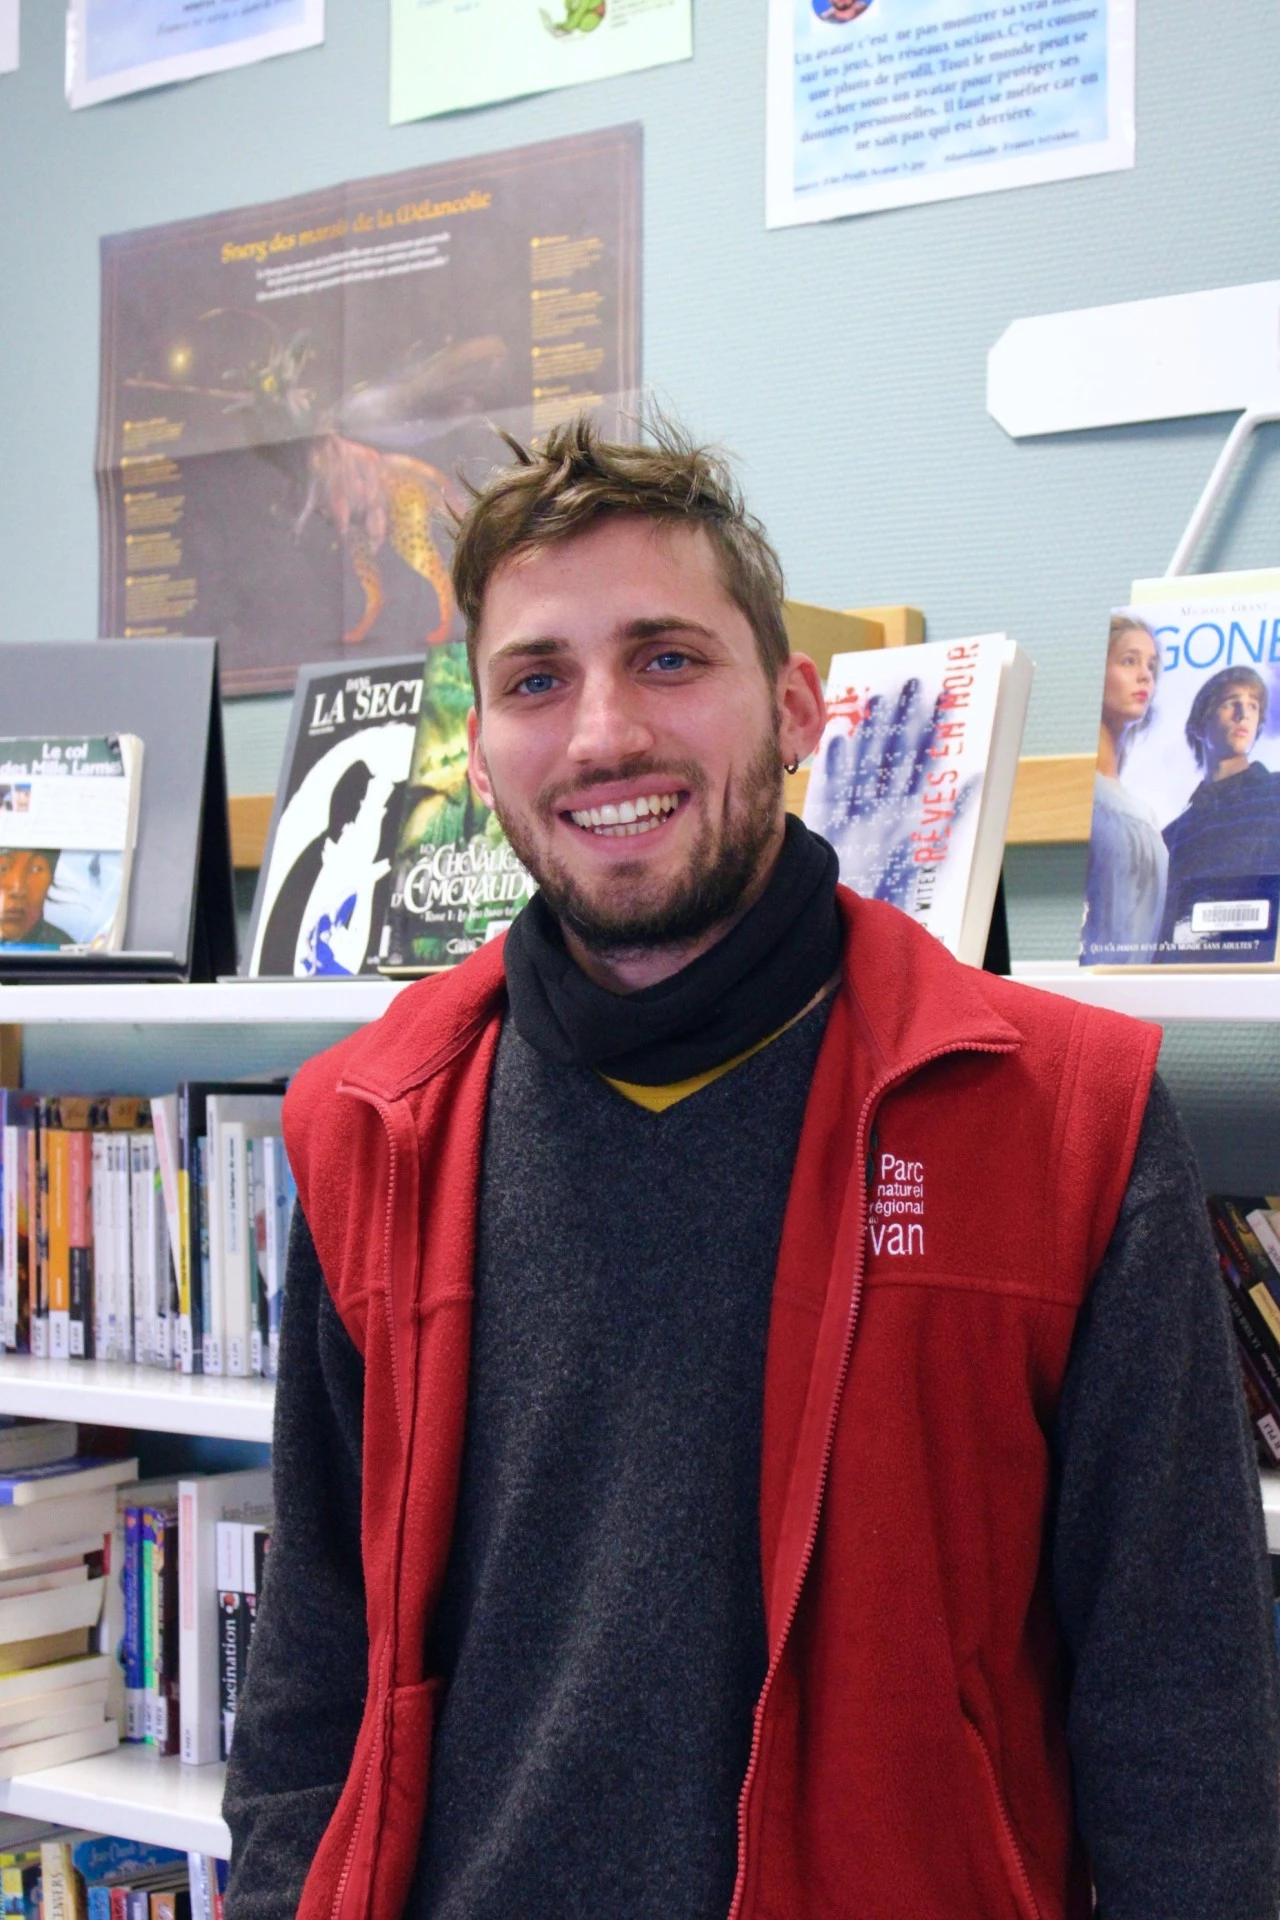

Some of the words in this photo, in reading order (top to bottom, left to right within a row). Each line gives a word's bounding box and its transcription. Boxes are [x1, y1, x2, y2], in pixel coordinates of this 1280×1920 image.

[816, 41, 854, 60] avatar
[896, 28, 911, 42] ne
[916, 22, 938, 42] pas
[942, 11, 996, 32] montrer
[822, 64, 839, 79] les
[877, 50, 894, 67] les
[898, 40, 949, 61] réseaux
[1047, 8, 1098, 27] comme
[809, 88, 831, 102] une
[874, 74, 889, 87] de
[939, 57, 970, 74] Tout
[973, 52, 985, 66] le
[989, 40, 1035, 63] monde
[1039, 33, 1070, 56] peut
[1074, 30, 1088, 43] se
[815, 100, 856, 120] cacher
[860, 94, 888, 110] sous
[892, 90, 910, 104] un
[914, 80, 957, 99] avatar
[961, 73, 993, 96] pour
[997, 58, 1054, 85] protéger
[1060, 53, 1080, 67] ses
[801, 123, 849, 144] données
[853, 104, 937, 134] personnelles.
[944, 97, 954, 112] Il
[958, 90, 985, 111] faut
[989, 89, 1002, 104] se
[1006, 80, 1048, 101] méfier
[1054, 75, 1076, 91] car
[1080, 71, 1099, 86] on
[856, 138, 870, 151] ne
[875, 131, 898, 147] sait
[901, 125, 925, 145] pas
[929, 118, 951, 142] qui
[955, 114, 972, 130] est
[351, 211, 375, 233] de
[377, 207, 394, 230] la
[942, 643, 980, 711] NOIR
[309, 689, 346, 728] LA
[352, 678, 424, 720] SECT
[31, 759, 68, 775] Mille
[42, 742, 61, 760] Le
[65, 742, 88, 760] col
[1203, 941, 1221, 950] SANS
[1222, 940, 1252, 950] ADULTES
[881, 1153, 924, 1182] Parc
[868, 1199, 924, 1217] régional
[877, 1182, 924, 1198] naturel
[221, 1617, 238, 1716] fascination
